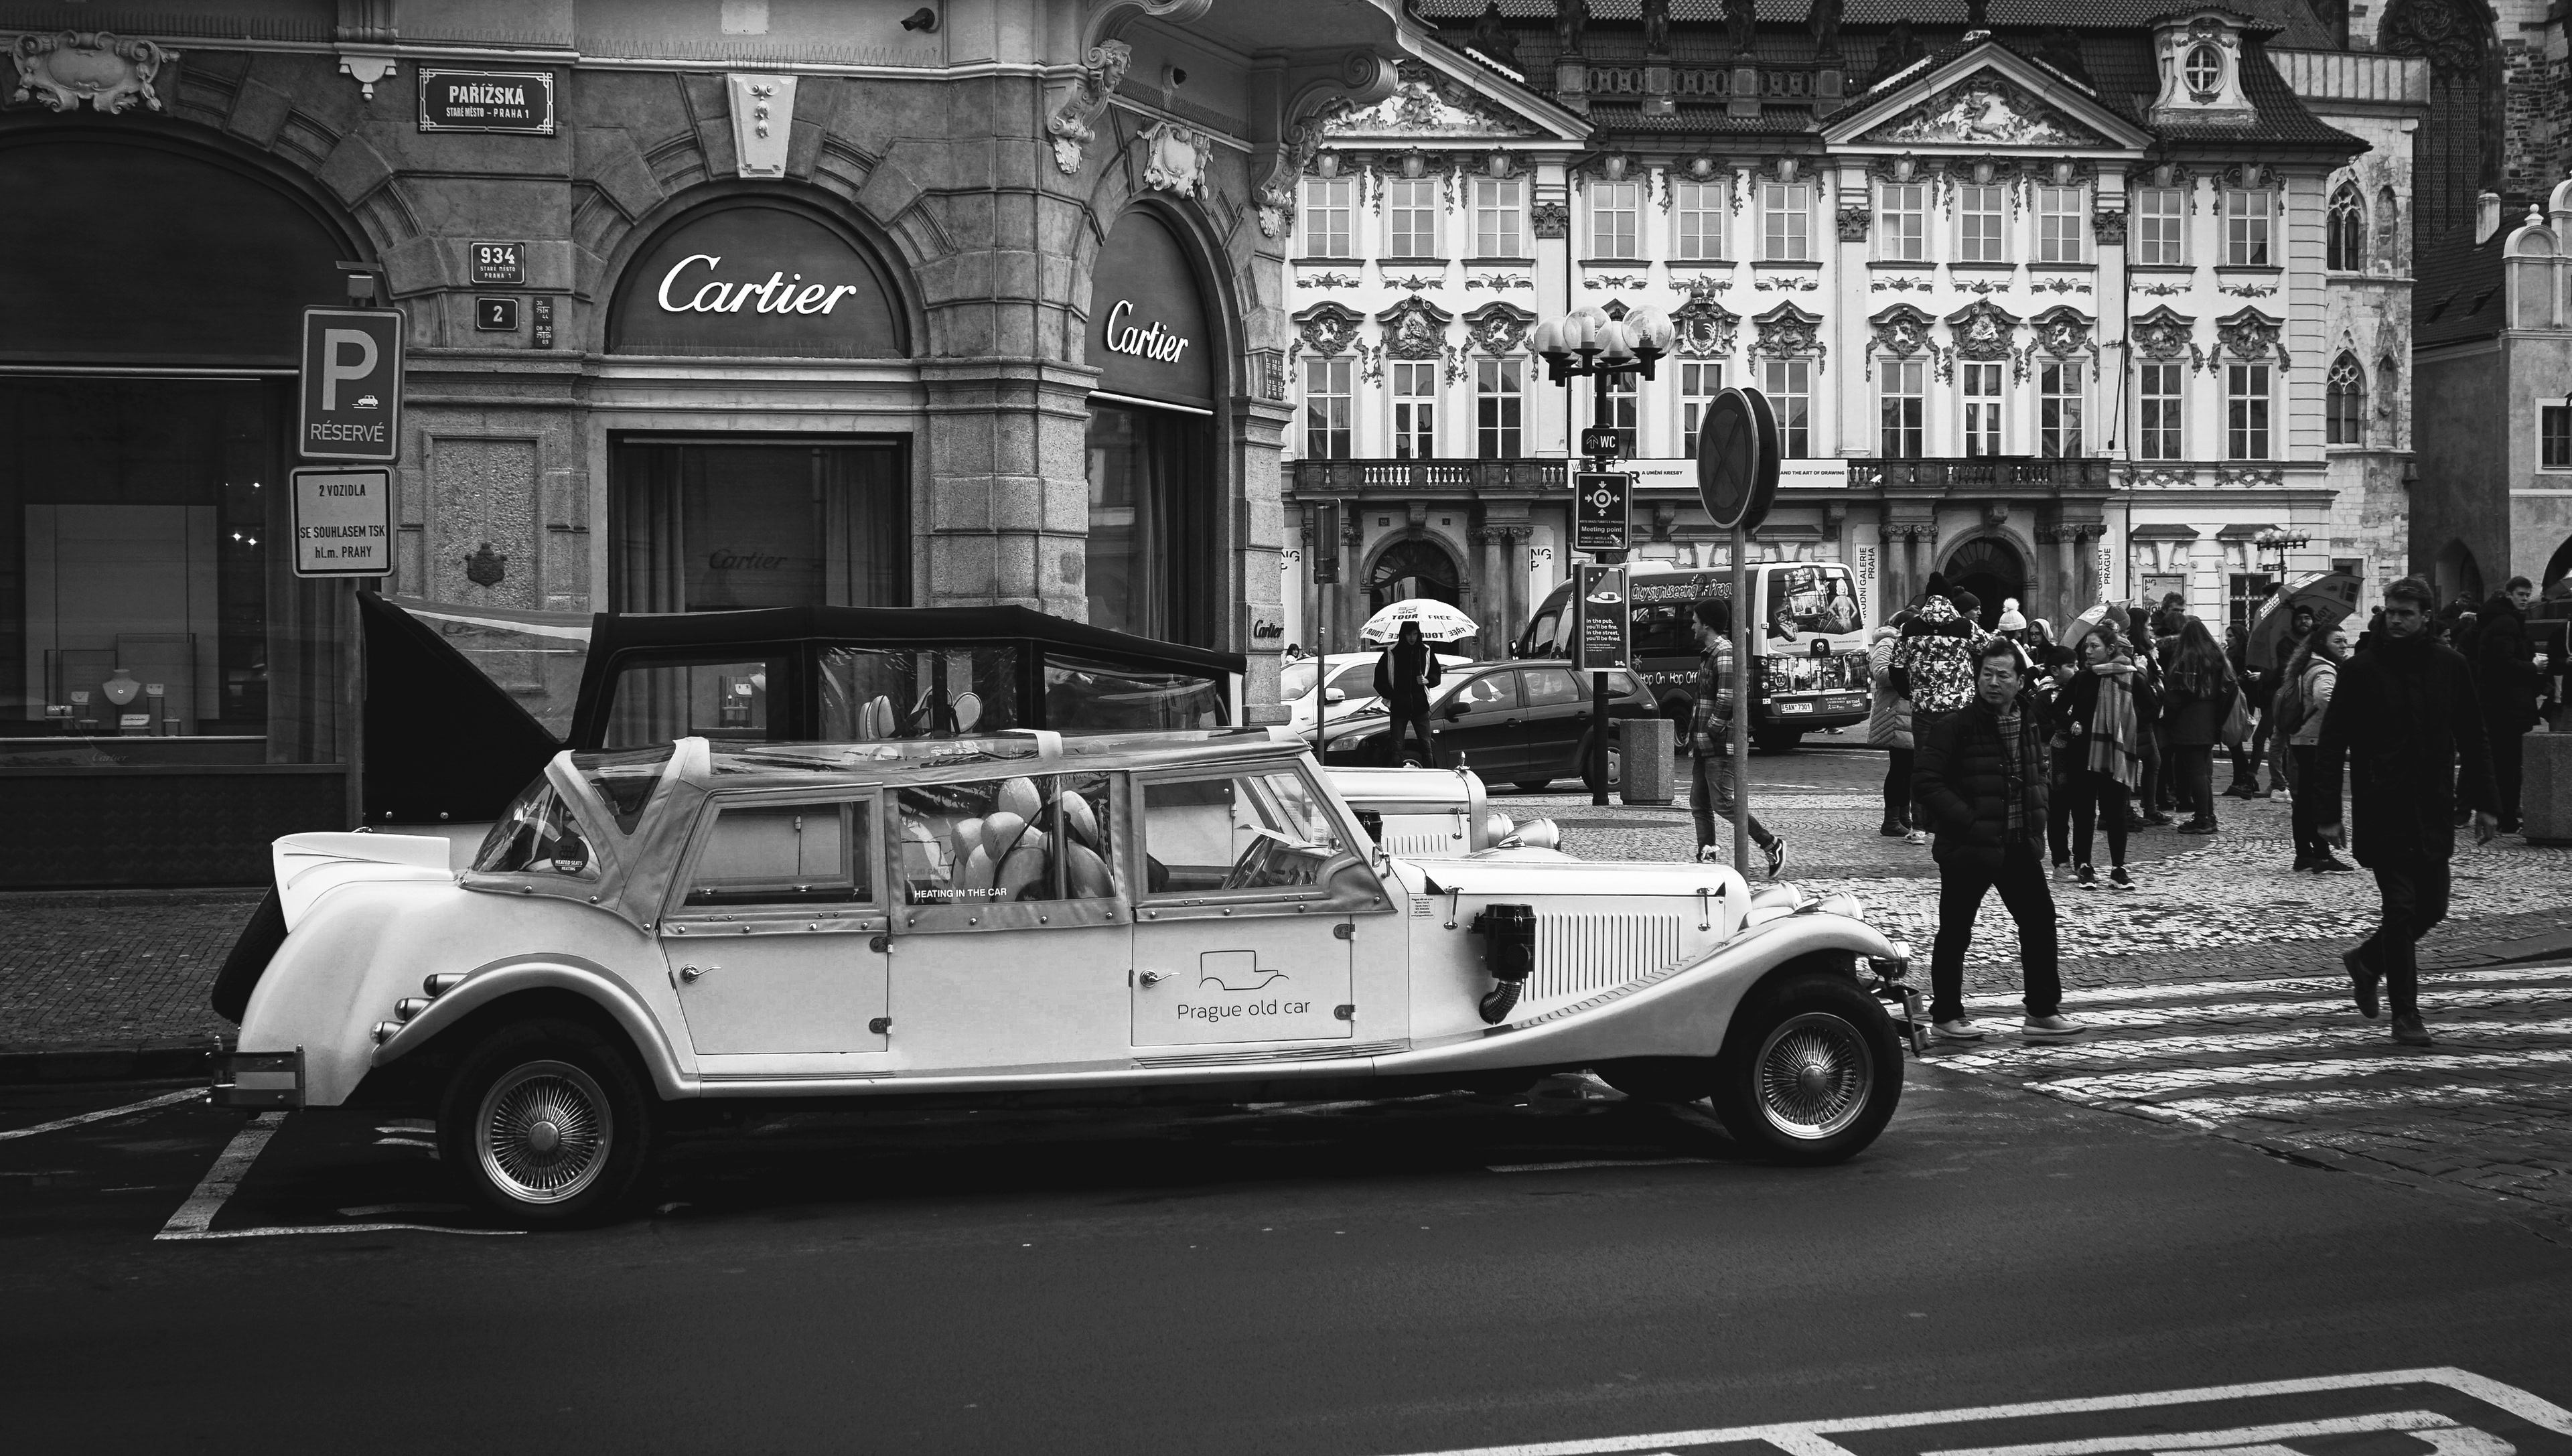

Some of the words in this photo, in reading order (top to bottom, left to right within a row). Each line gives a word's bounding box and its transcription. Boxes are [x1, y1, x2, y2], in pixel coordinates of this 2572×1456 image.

[449, 82, 525, 105] PAŘÍŽSKÁ
[446, 106, 464, 117] STARÉ
[464, 106, 484, 117] MĚSTO
[494, 108, 522, 119] PRAHA
[525, 109, 529, 119] 1
[480, 247, 515, 264] 934
[658, 254, 857, 314] Cartier
[493, 305, 502, 322] 2
[1107, 299, 1189, 363] Cartier
[322, 328, 378, 411] P
[310, 420, 384, 442] RÉSERVÉ
[1600, 435, 1616, 448] WC
[319, 485, 325, 497] 2
[327, 484, 366, 497] VOZIDLA
[300, 526, 311, 538] SE
[313, 525, 366, 538] SOUHLASEM
[368, 525, 385, 537] TSK
[342, 546, 372, 558] PRAHY
[709, 549, 788, 569] Cartier
[1253, 620, 1284, 638] Cartier
[1640, 673, 1654, 685] Hop
[1655, 672, 1665, 684] On
[1669, 672, 1684, 685] Hop
[1686, 671, 1699, 684] Off
[914, 889, 953, 898] HEATING
[956, 889, 965, 897] IN
[967, 889, 985, 897] THE
[987, 887, 1007, 896] CAR
[1177, 1005, 1242, 1023] Prague
[1248, 999, 1277, 1016] old
[1283, 1001, 1311, 1014] car
